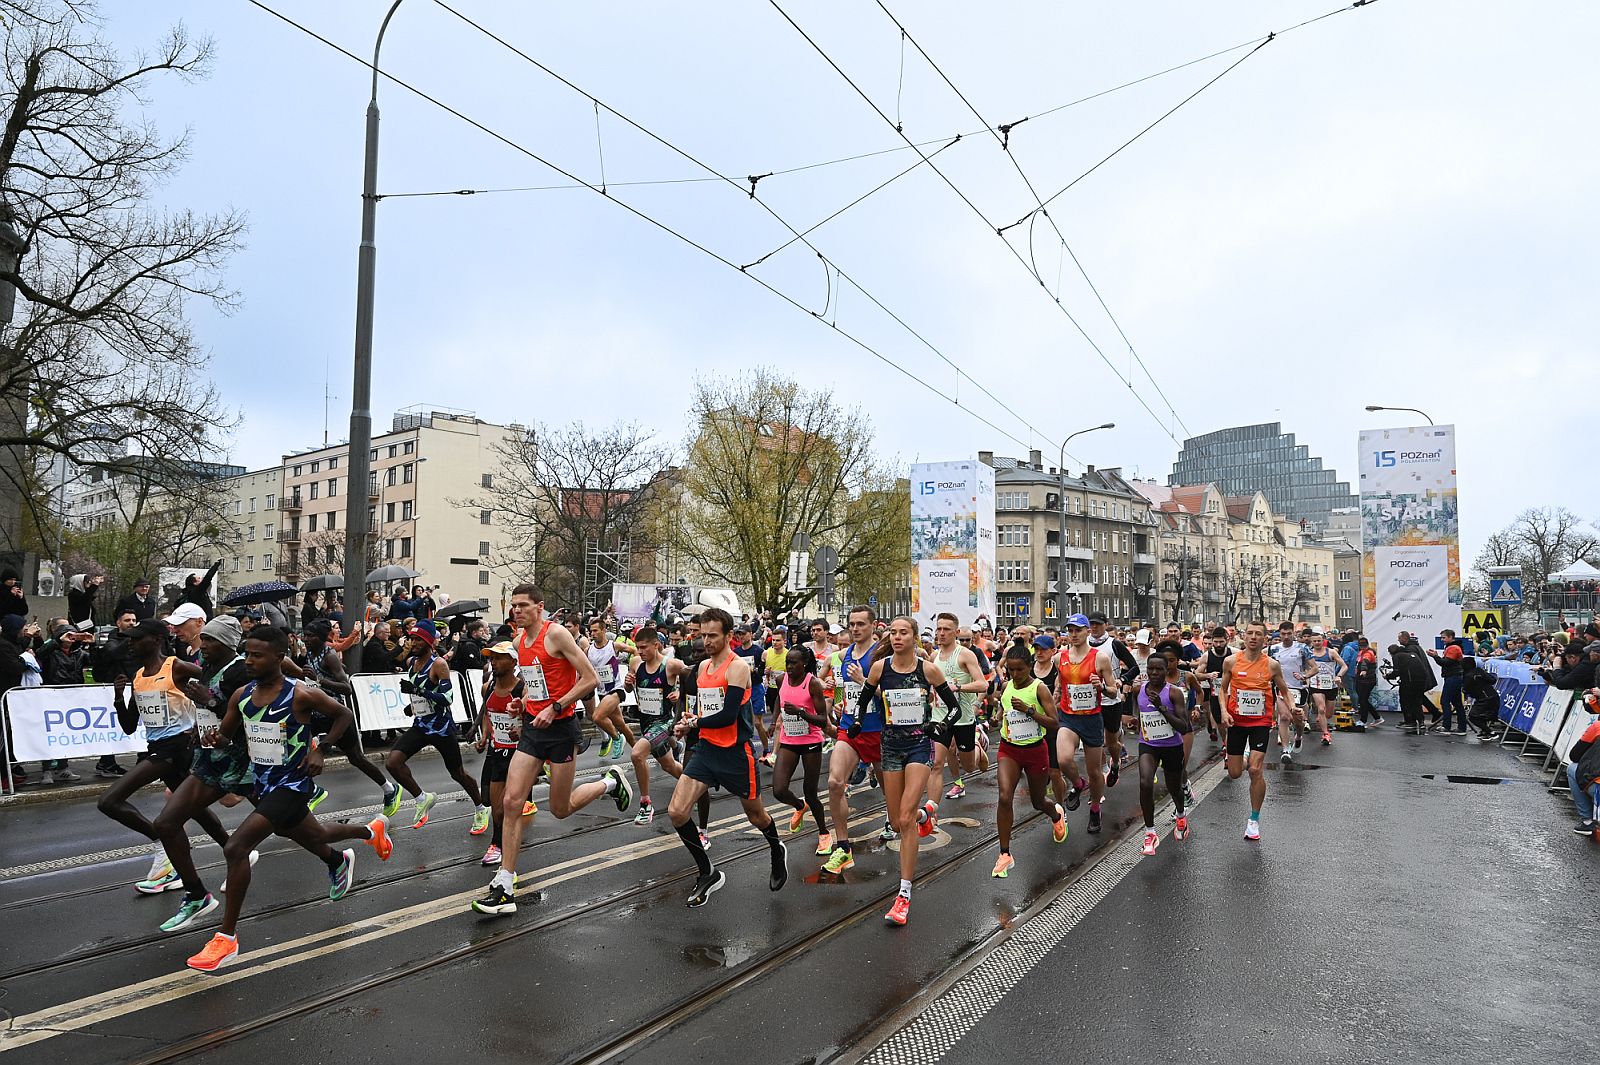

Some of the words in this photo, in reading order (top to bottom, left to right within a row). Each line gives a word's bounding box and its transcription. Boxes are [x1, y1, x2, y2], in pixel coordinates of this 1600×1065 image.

[1373, 450, 1396, 467] 15
[919, 481, 935, 495] 15
[1380, 506, 1440, 522] START
[924, 527, 962, 538] START
[1462, 613, 1502, 634] AA
[1073, 691, 1093, 700] 6033
[139, 706, 160, 714] PACE
[250, 724, 259, 733] 15
